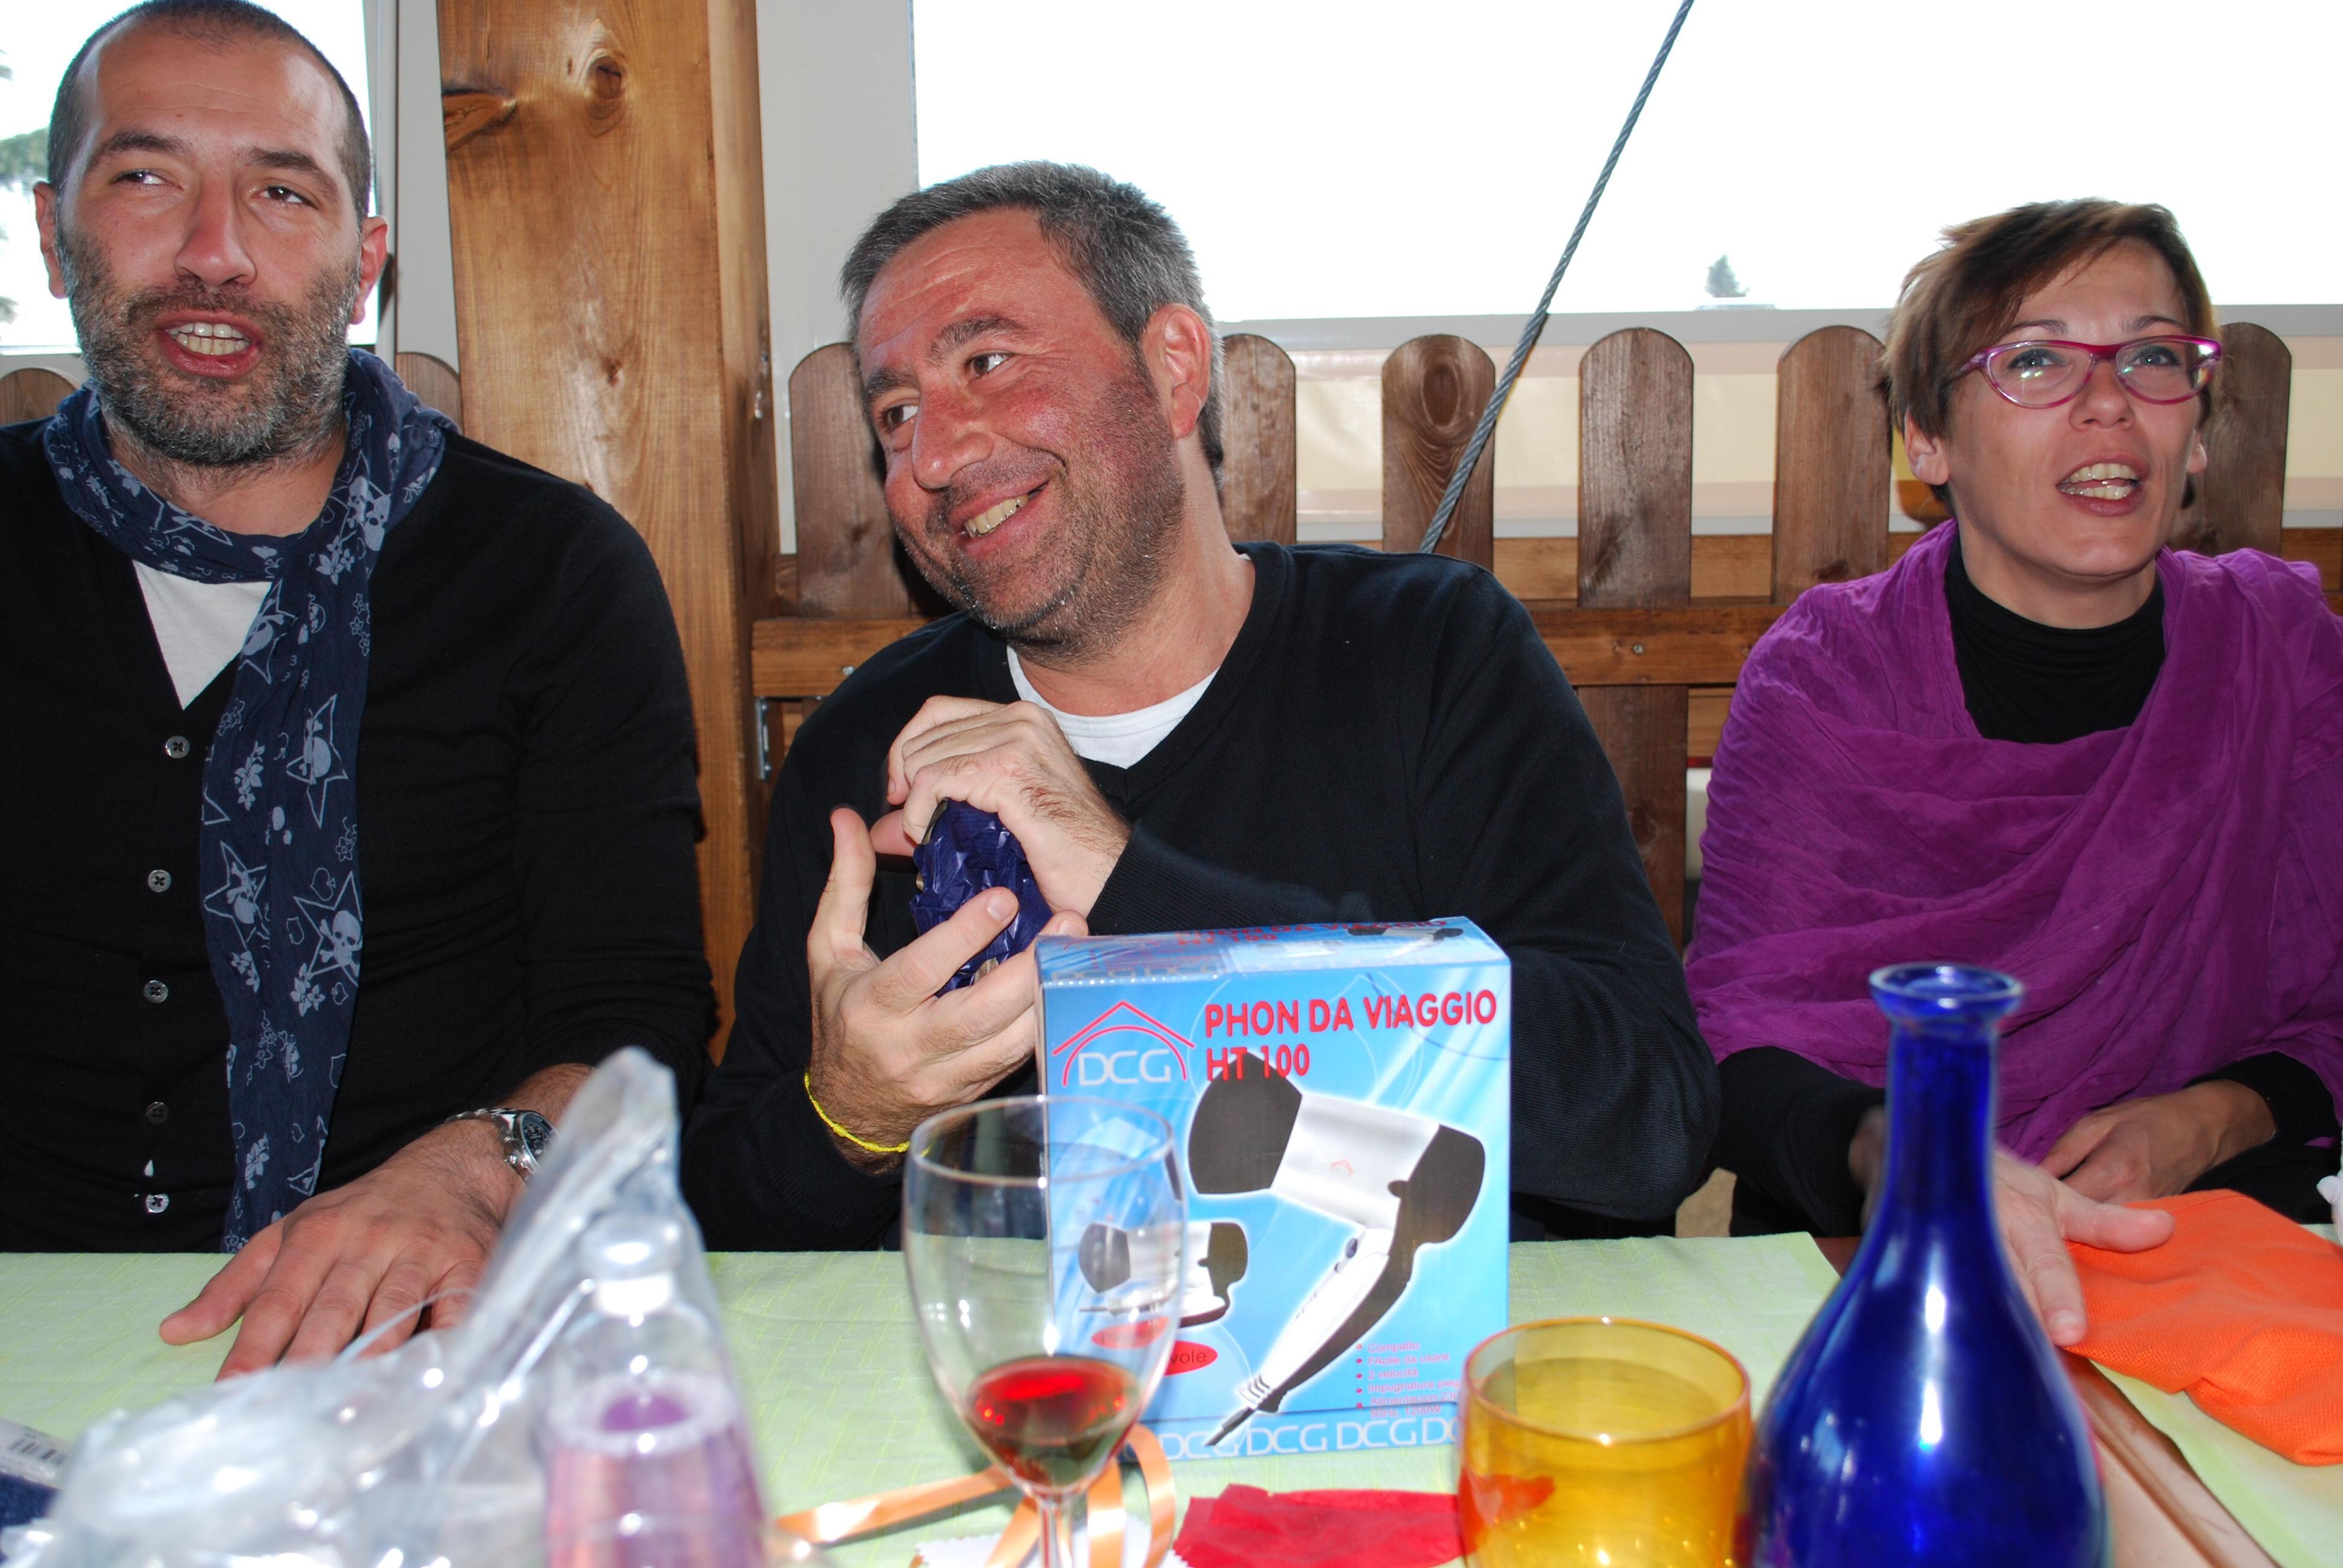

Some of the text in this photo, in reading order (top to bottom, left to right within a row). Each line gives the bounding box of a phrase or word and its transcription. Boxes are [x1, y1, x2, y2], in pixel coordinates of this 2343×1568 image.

[1205, 989, 1498, 1039] PHON DA VIAGGIO
[1078, 1049, 1171, 1086] DCG
[1207, 1044, 1310, 1082] HT 100
[1368, 1342, 1419, 1354] Compatto
[1403, 1354, 1417, 1364] da
[1420, 1353, 1450, 1362] usare
[1368, 1370, 1375, 1380] 2
[1368, 1380, 1434, 1394] Impugnatura
[1404, 1405, 1442, 1416] 1200W
[1248, 1424, 1326, 1454] DCG
[1338, 1419, 1415, 1449] DCG
